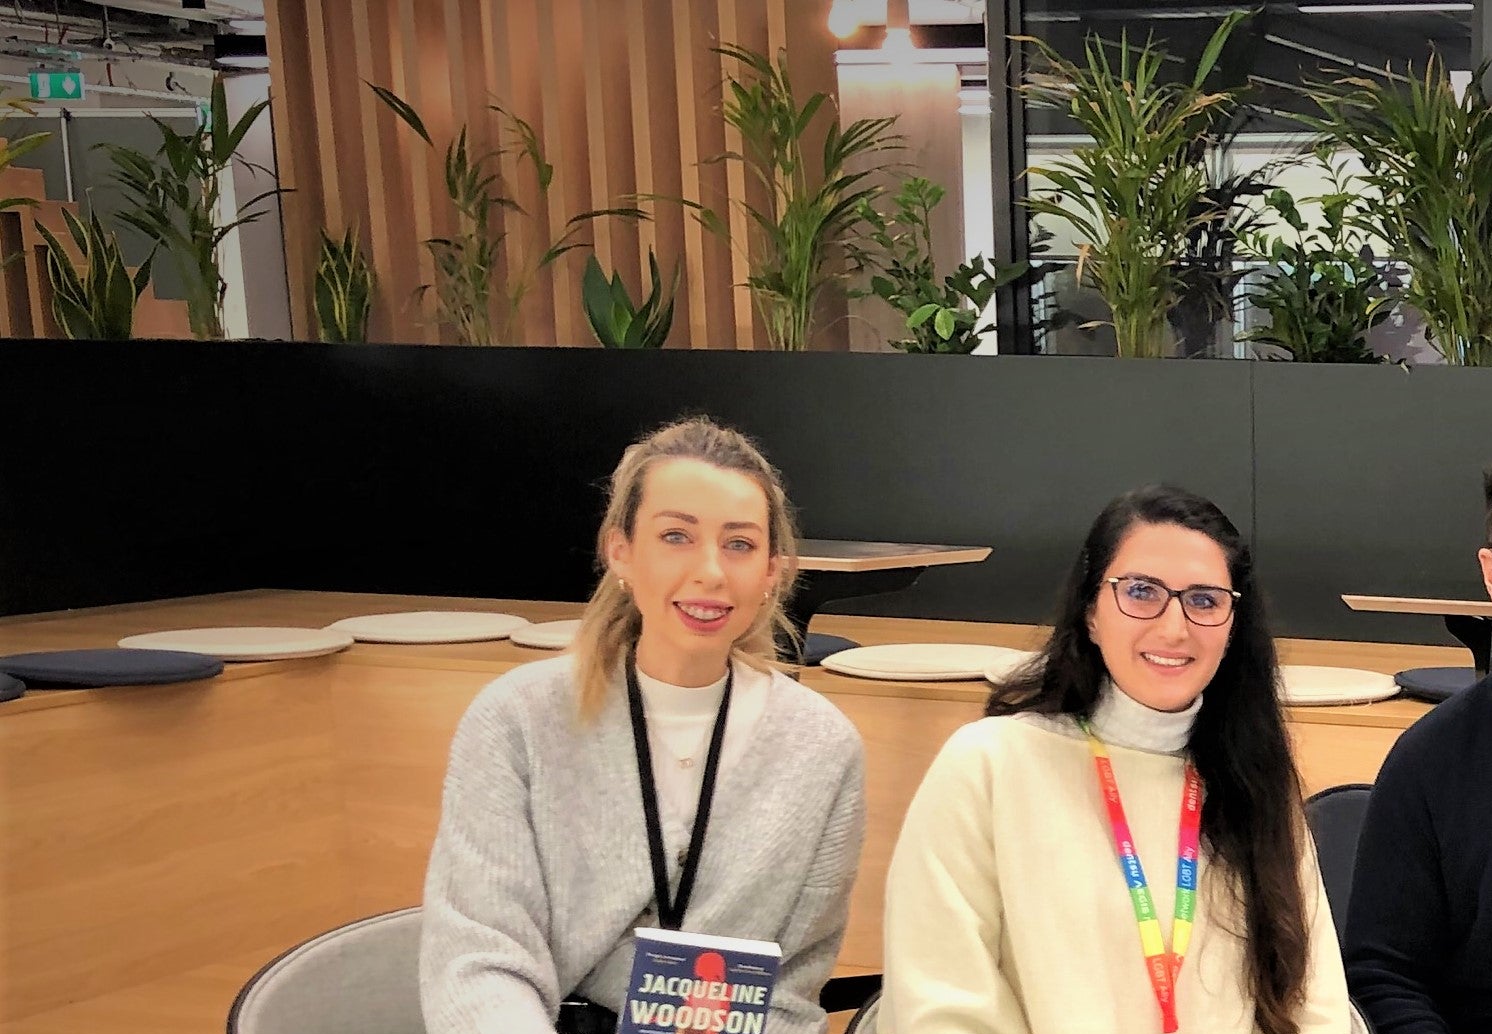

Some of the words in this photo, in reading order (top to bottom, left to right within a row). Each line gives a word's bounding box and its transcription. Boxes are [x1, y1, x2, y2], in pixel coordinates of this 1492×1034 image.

[1121, 841, 1140, 877] dentsu
[1180, 863, 1193, 888] LGBT
[638, 974, 768, 1006] JACQUELINE
